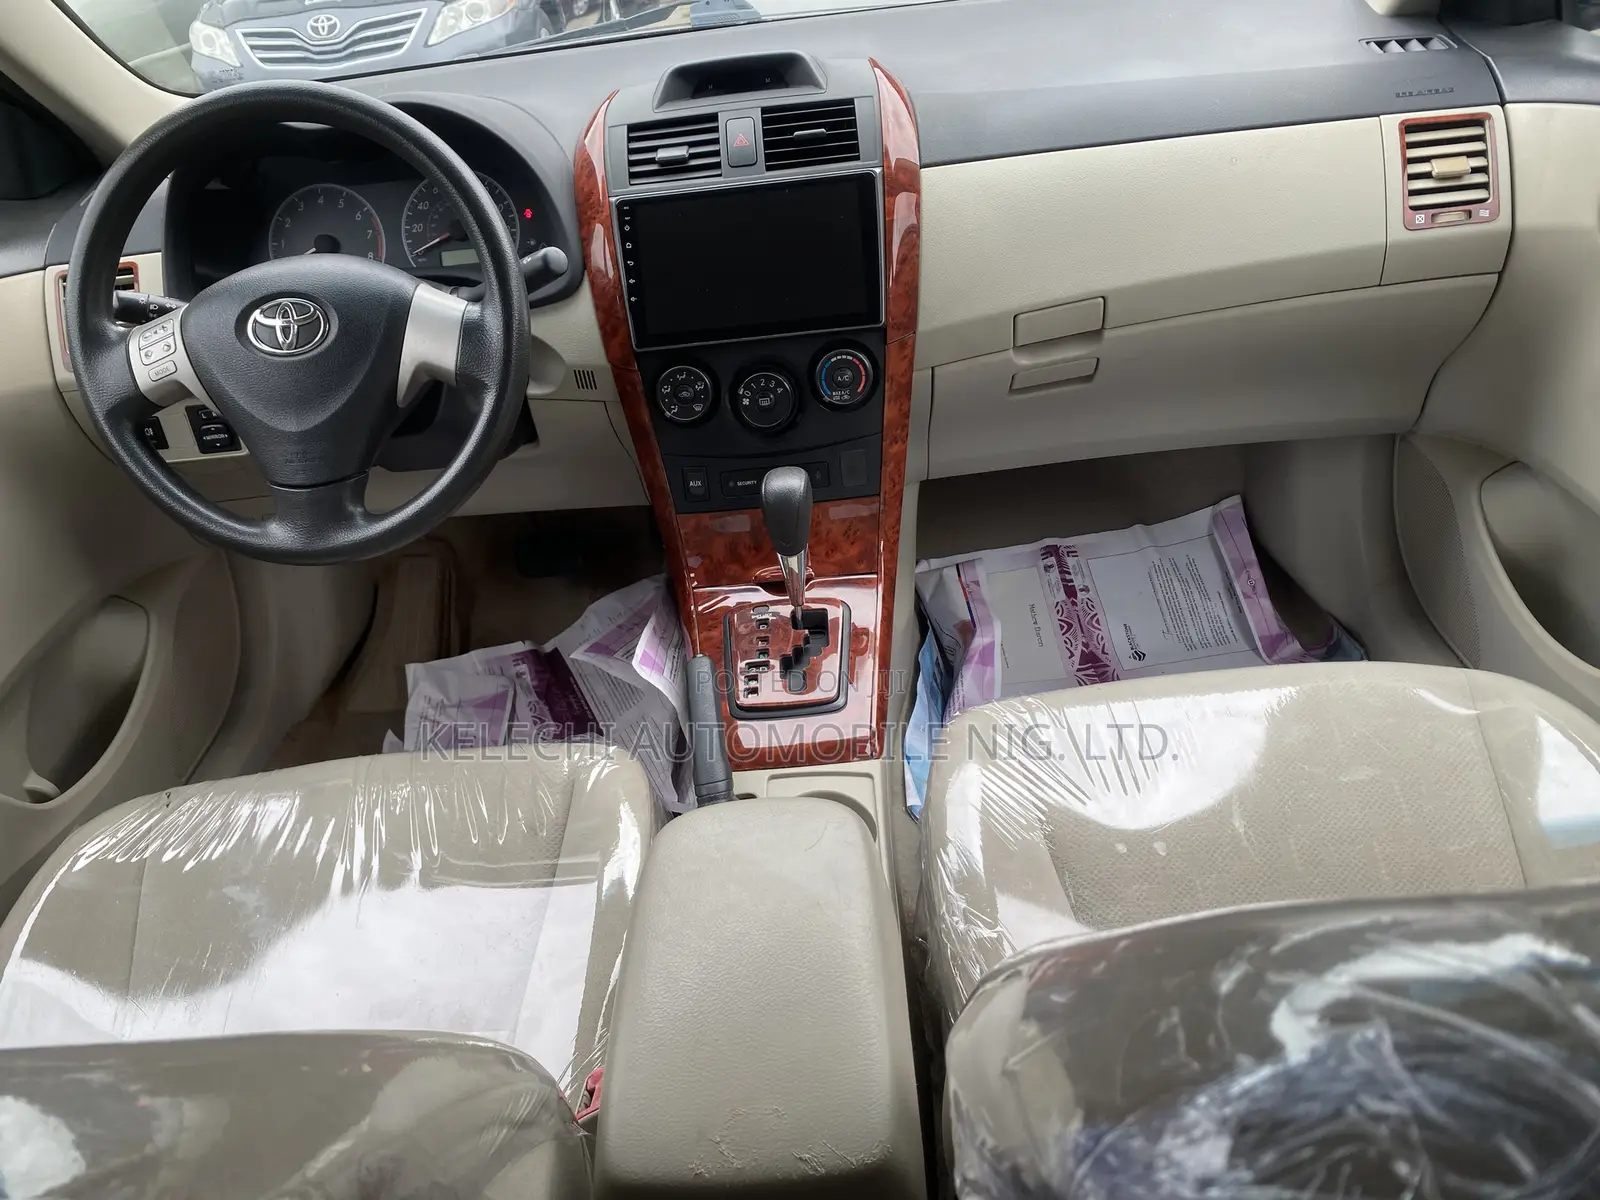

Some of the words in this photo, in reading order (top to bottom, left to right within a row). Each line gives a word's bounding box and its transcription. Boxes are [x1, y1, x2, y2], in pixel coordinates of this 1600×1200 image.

[317, 195, 324, 204] 4
[337, 198, 344, 208] 5
[297, 201, 304, 211] 3
[417, 200, 429, 210] 40
[355, 211, 361, 220] 6
[284, 217, 291, 228] 2
[411, 223, 423, 232] 20
[366, 229, 373, 240] 7
[367, 251, 374, 260] 8
[154, 366, 171, 377] MODE
[760, 378, 765, 386] 2
[769, 380, 775, 388] 3
[837, 374, 850, 382] A/C
